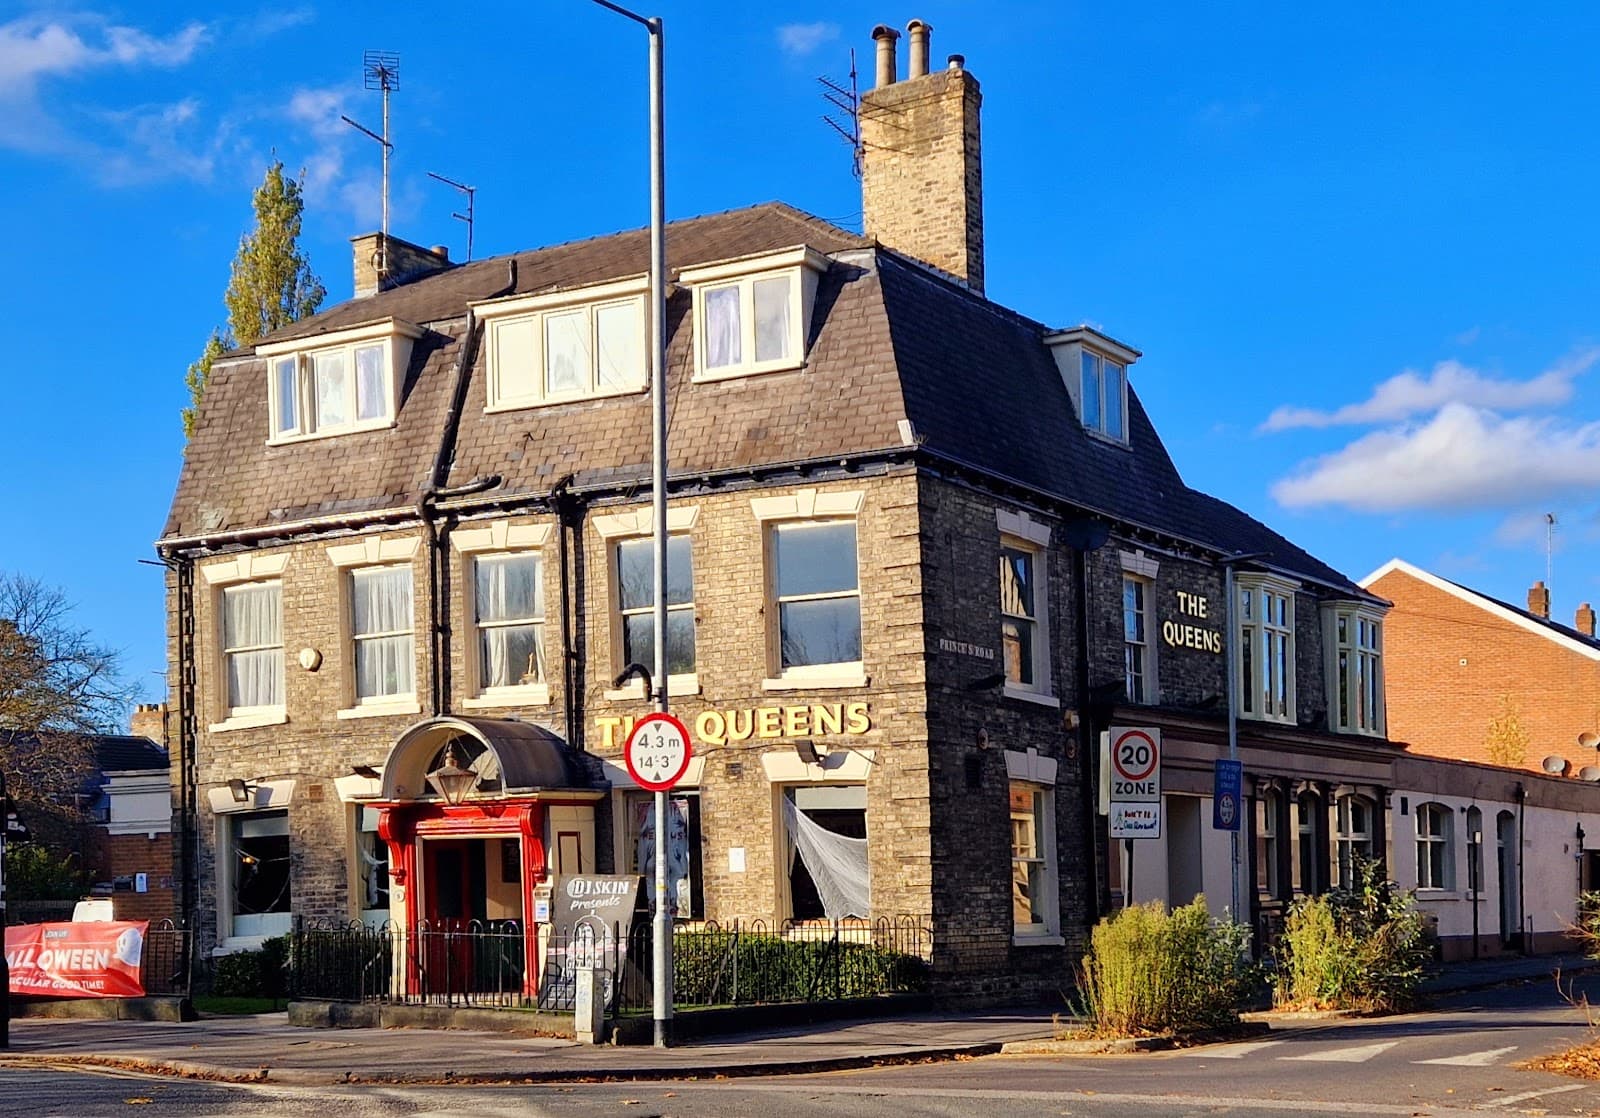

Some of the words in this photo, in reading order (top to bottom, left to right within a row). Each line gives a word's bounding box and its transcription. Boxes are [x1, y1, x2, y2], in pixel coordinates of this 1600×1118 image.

[1177, 591, 1207, 618] THE
[1163, 620, 1221, 653] QUEENS
[975, 646, 994, 660] ROAD
[695, 702, 871, 746] QUEENS
[638, 733, 664, 749] 4.3
[1121, 745, 1150, 765] 20
[1115, 782, 1155, 795] ZONE
[593, 881, 629, 894] SKIN
[570, 895, 620, 911] presents
[7, 948, 109, 970] ALLOWEEN
